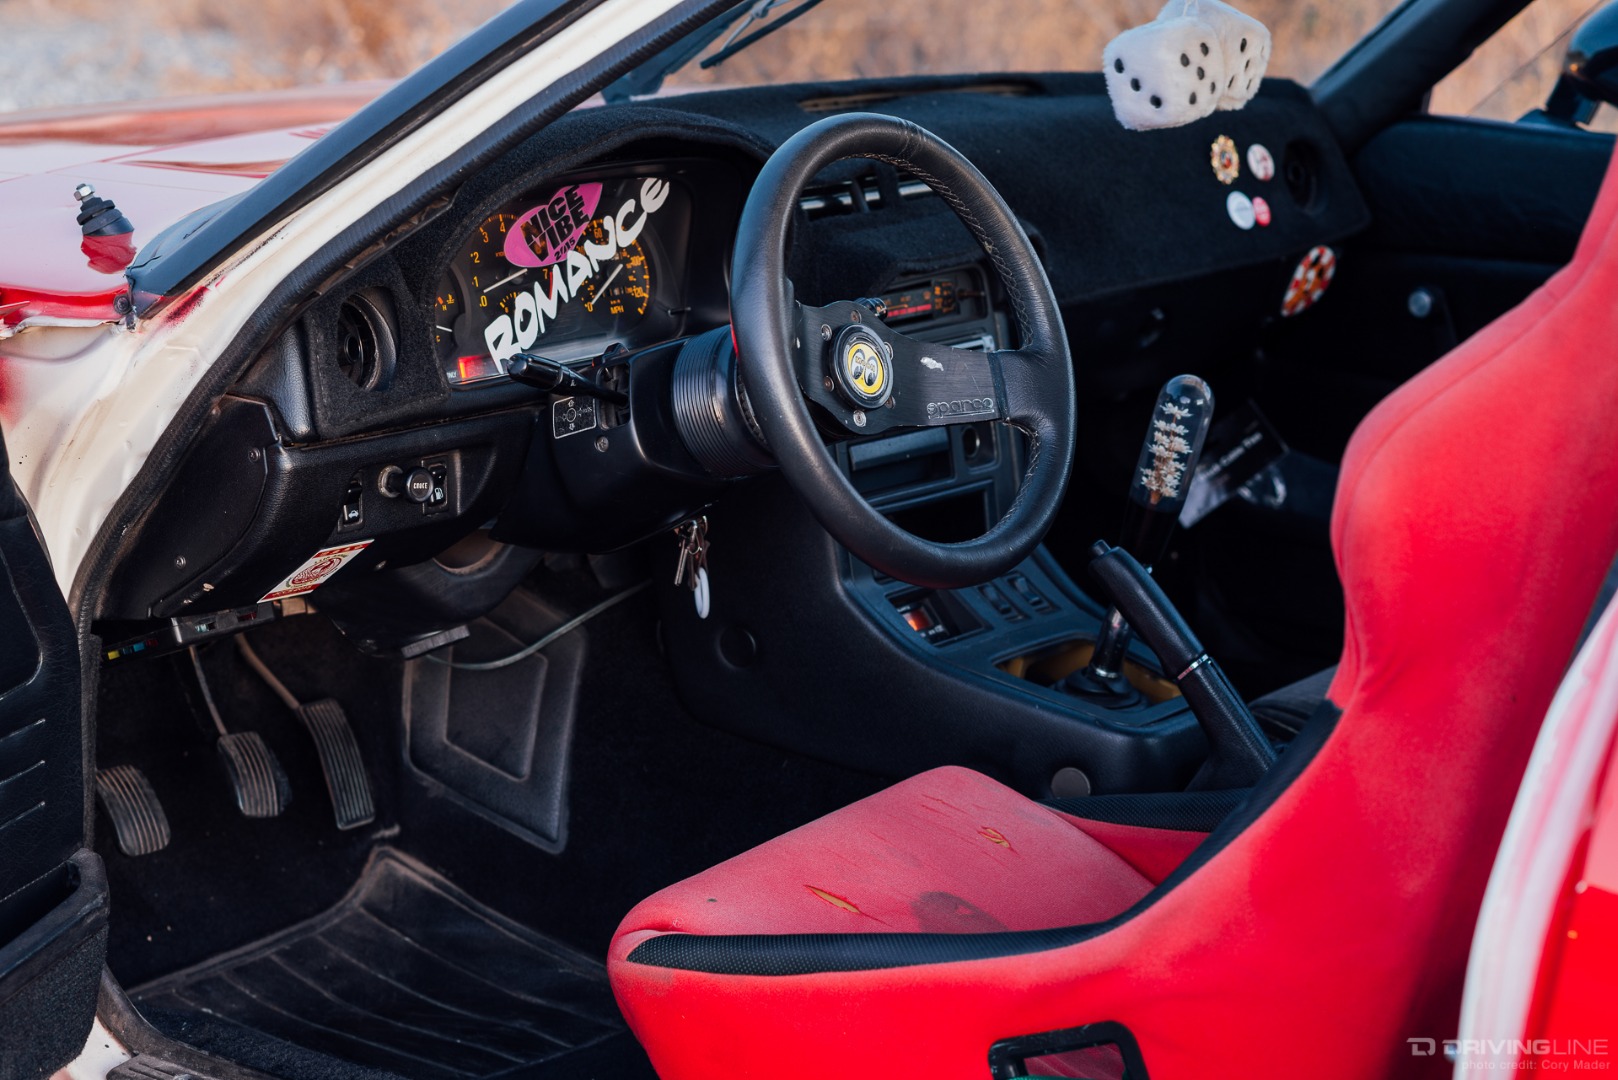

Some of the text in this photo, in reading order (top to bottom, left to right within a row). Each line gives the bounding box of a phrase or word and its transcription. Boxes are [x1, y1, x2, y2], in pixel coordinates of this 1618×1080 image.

[520, 184, 583, 246] NICE
[499, 221, 506, 233] 4
[528, 201, 591, 262] VIBE
[482, 231, 489, 243] 3
[473, 251, 480, 263] 2
[484, 177, 670, 375] ROMANCE
[542, 268, 548, 280] 7
[480, 295, 488, 307] 0
[587, 301, 594, 312] 0
